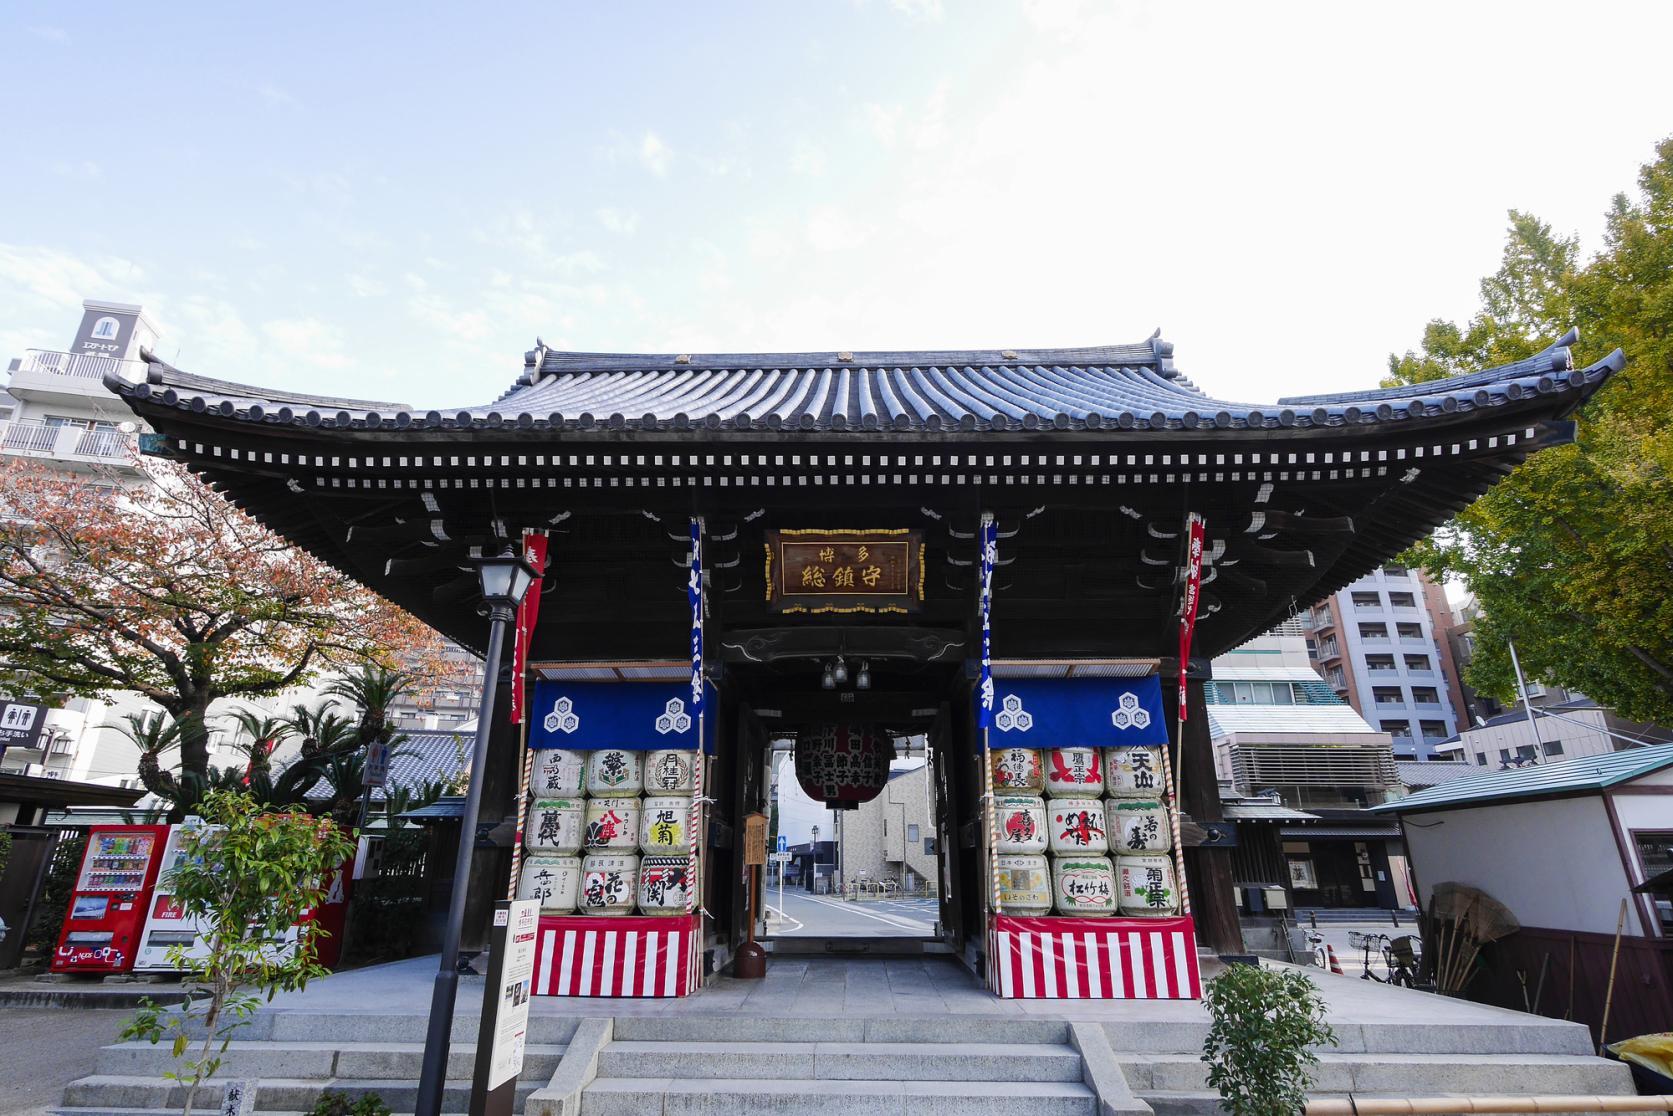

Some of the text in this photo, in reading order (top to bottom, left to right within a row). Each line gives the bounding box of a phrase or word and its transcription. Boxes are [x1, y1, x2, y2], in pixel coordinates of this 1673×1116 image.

[819, 546, 870, 563] 博多
[801, 565, 882, 588] 総鎮守
[662, 753, 680, 790] 月桂冠
[1131, 753, 1154, 788] 天山
[655, 810, 678, 845] 旭菊
[1068, 879, 1110, 896] 松竹梅
[1145, 867, 1167, 908] 菊正宗
[160, 911, 178, 919] FIRE
